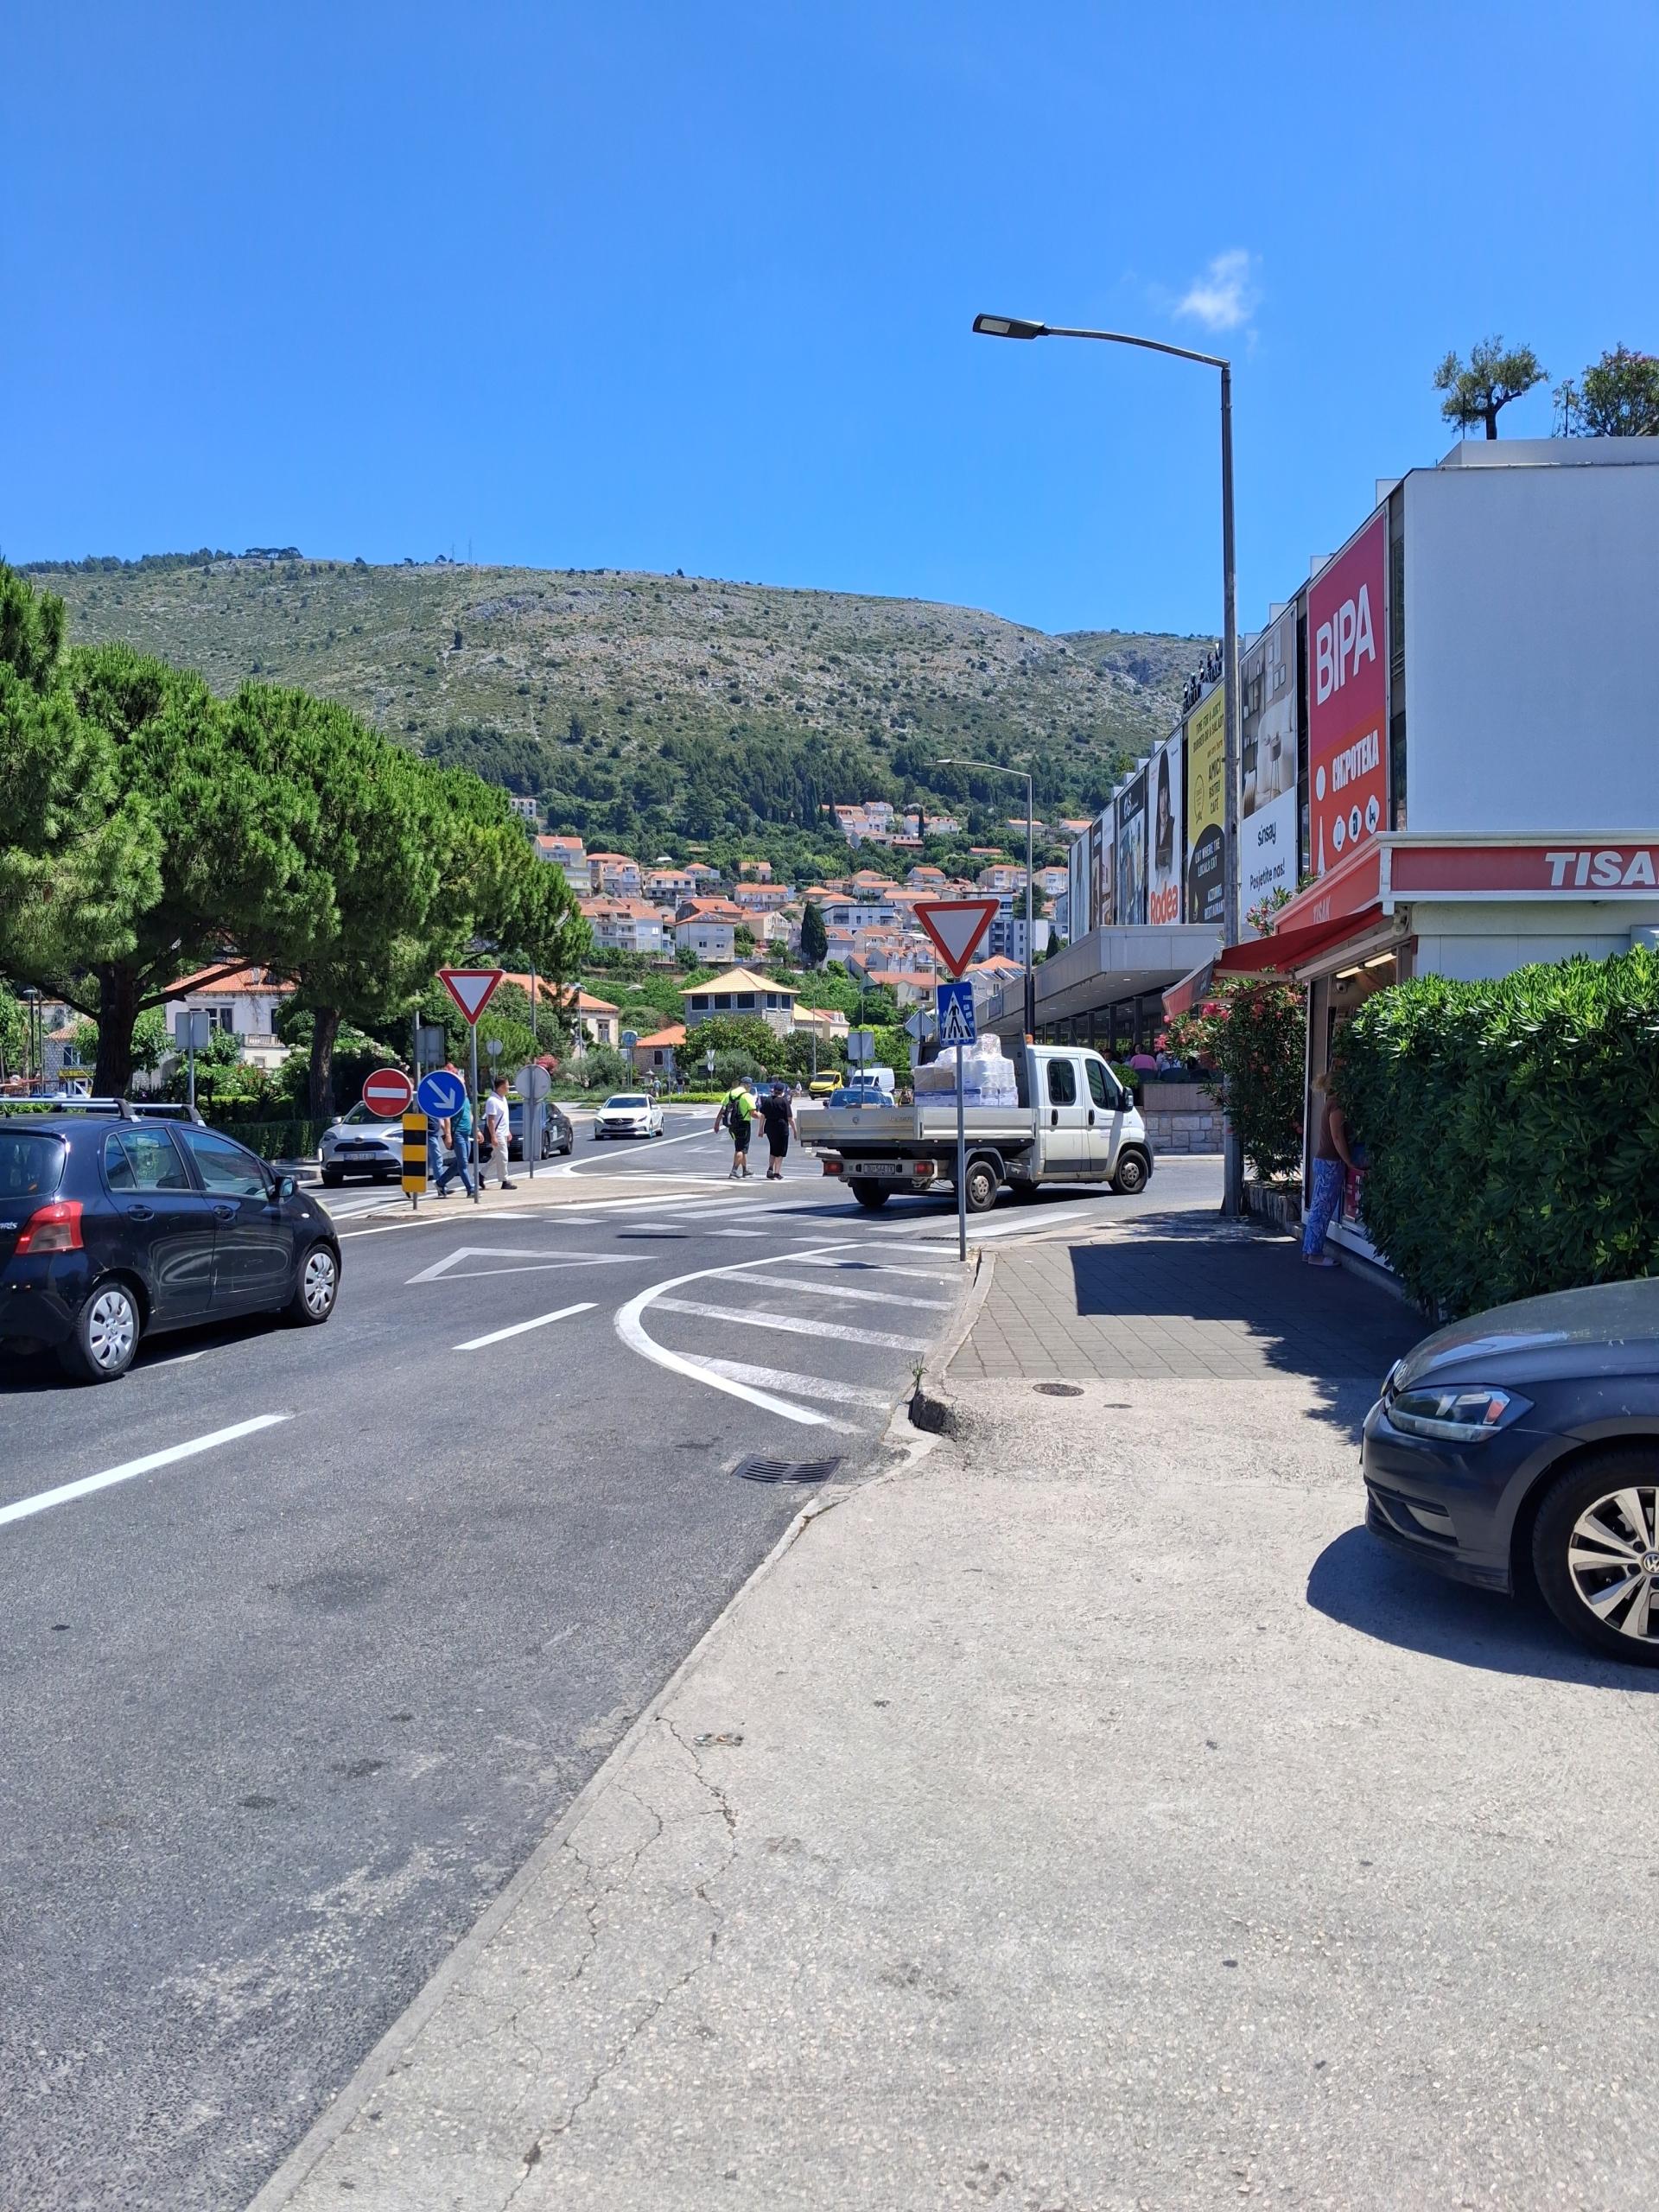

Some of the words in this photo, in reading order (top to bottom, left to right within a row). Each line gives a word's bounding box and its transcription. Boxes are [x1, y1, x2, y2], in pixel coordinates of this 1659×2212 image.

[1316, 583, 1376, 706] BIPA
[1257, 822, 1276, 847] sinsay
[1249, 866, 1273, 892] Posjetite
[1273, 856, 1286, 879] nas!
[1545, 850, 1659, 887] TISA
[1150, 884, 1179, 925] Rodea
